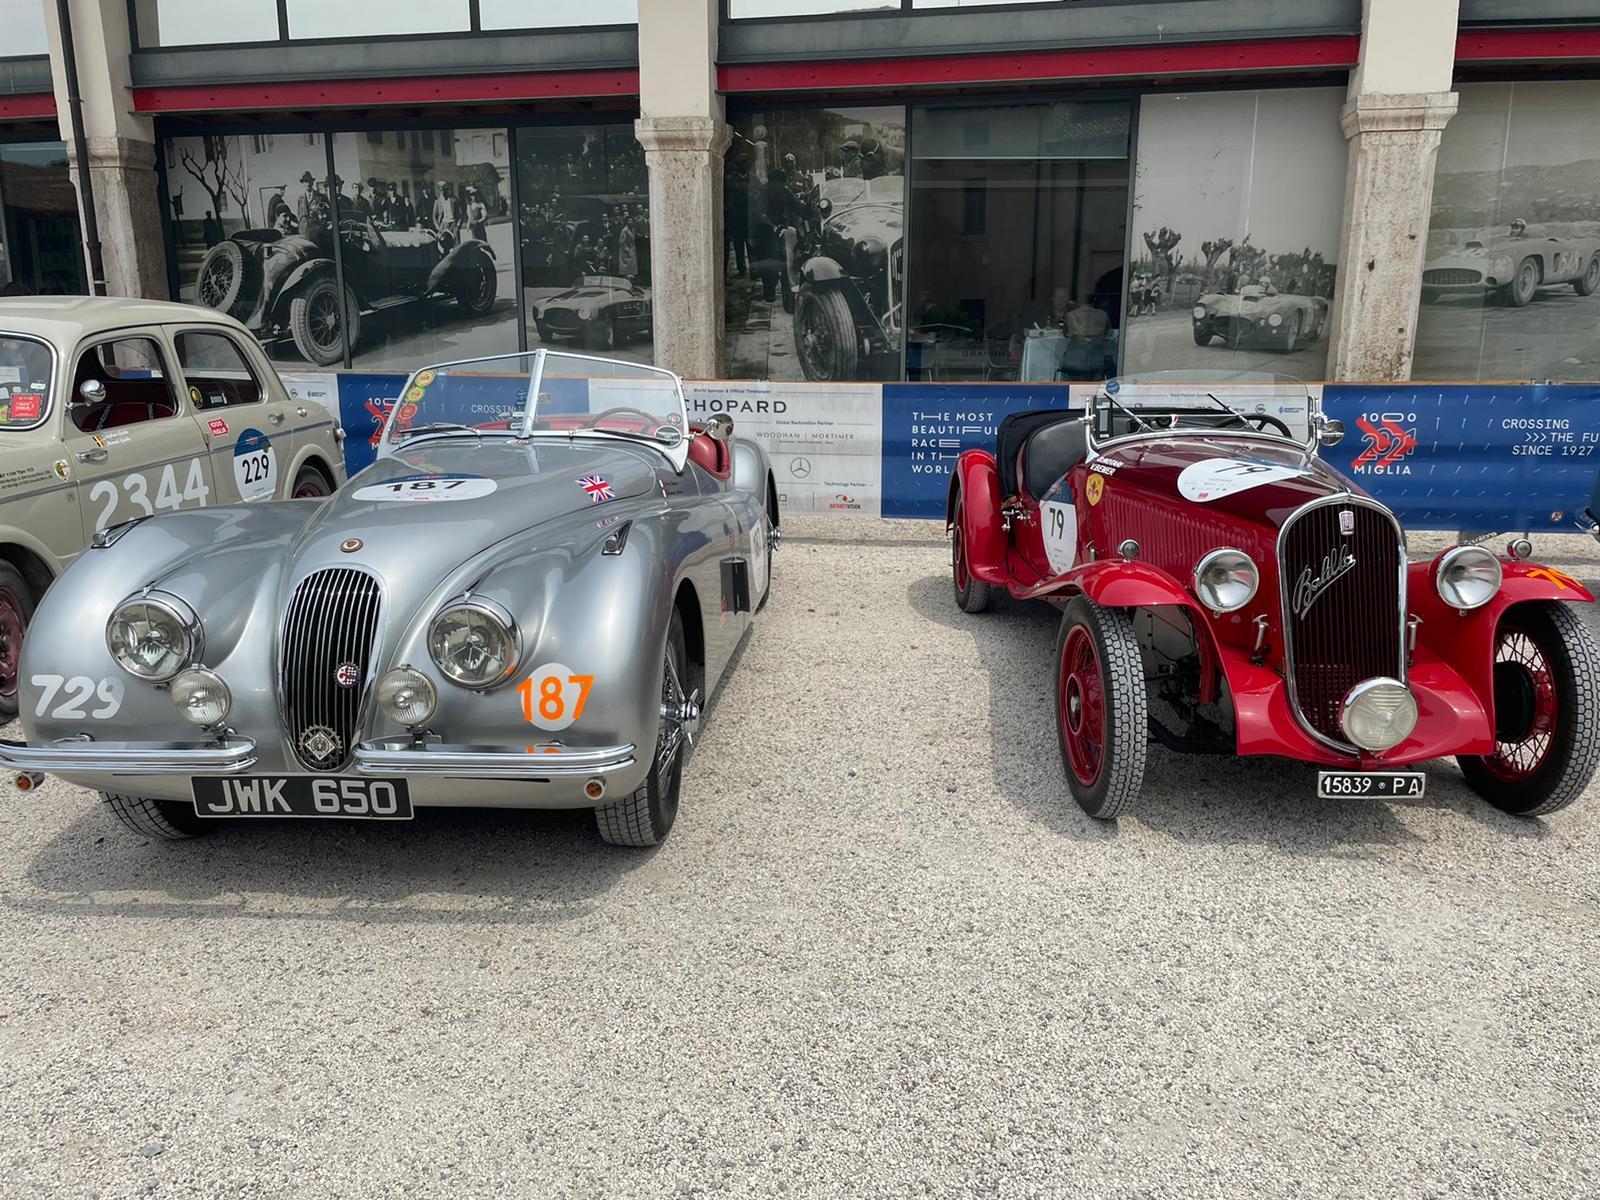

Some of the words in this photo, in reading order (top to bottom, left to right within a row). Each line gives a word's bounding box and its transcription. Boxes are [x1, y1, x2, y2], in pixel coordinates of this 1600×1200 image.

[912, 412, 950, 421] THE
[956, 412, 993, 421] MOST
[1361, 412, 1417, 422] 1000
[1502, 418, 1570, 429] CROSSING
[912, 425, 999, 435] BEAUTIFUL
[1550, 432, 1574, 442] THE
[911, 438, 960, 448] RACE
[1512, 444, 1553, 456] SINCE
[1561, 445, 1594, 456] 1927
[911, 452, 924, 460] IN
[930, 452, 960, 460] TH
[242, 454, 269, 484] 229
[911, 464, 950, 474] WORL
[1353, 464, 1412, 475] MIGLIA
[386, 480, 466, 492] 187
[90, 457, 209, 531] 2344
[1049, 507, 1065, 540] 79
[31, 674, 125, 719] 729
[516, 675, 595, 721] 187
[1324, 777, 1371, 793] 15839
[207, 779, 292, 813] JWK
[311, 779, 398, 814] 650
